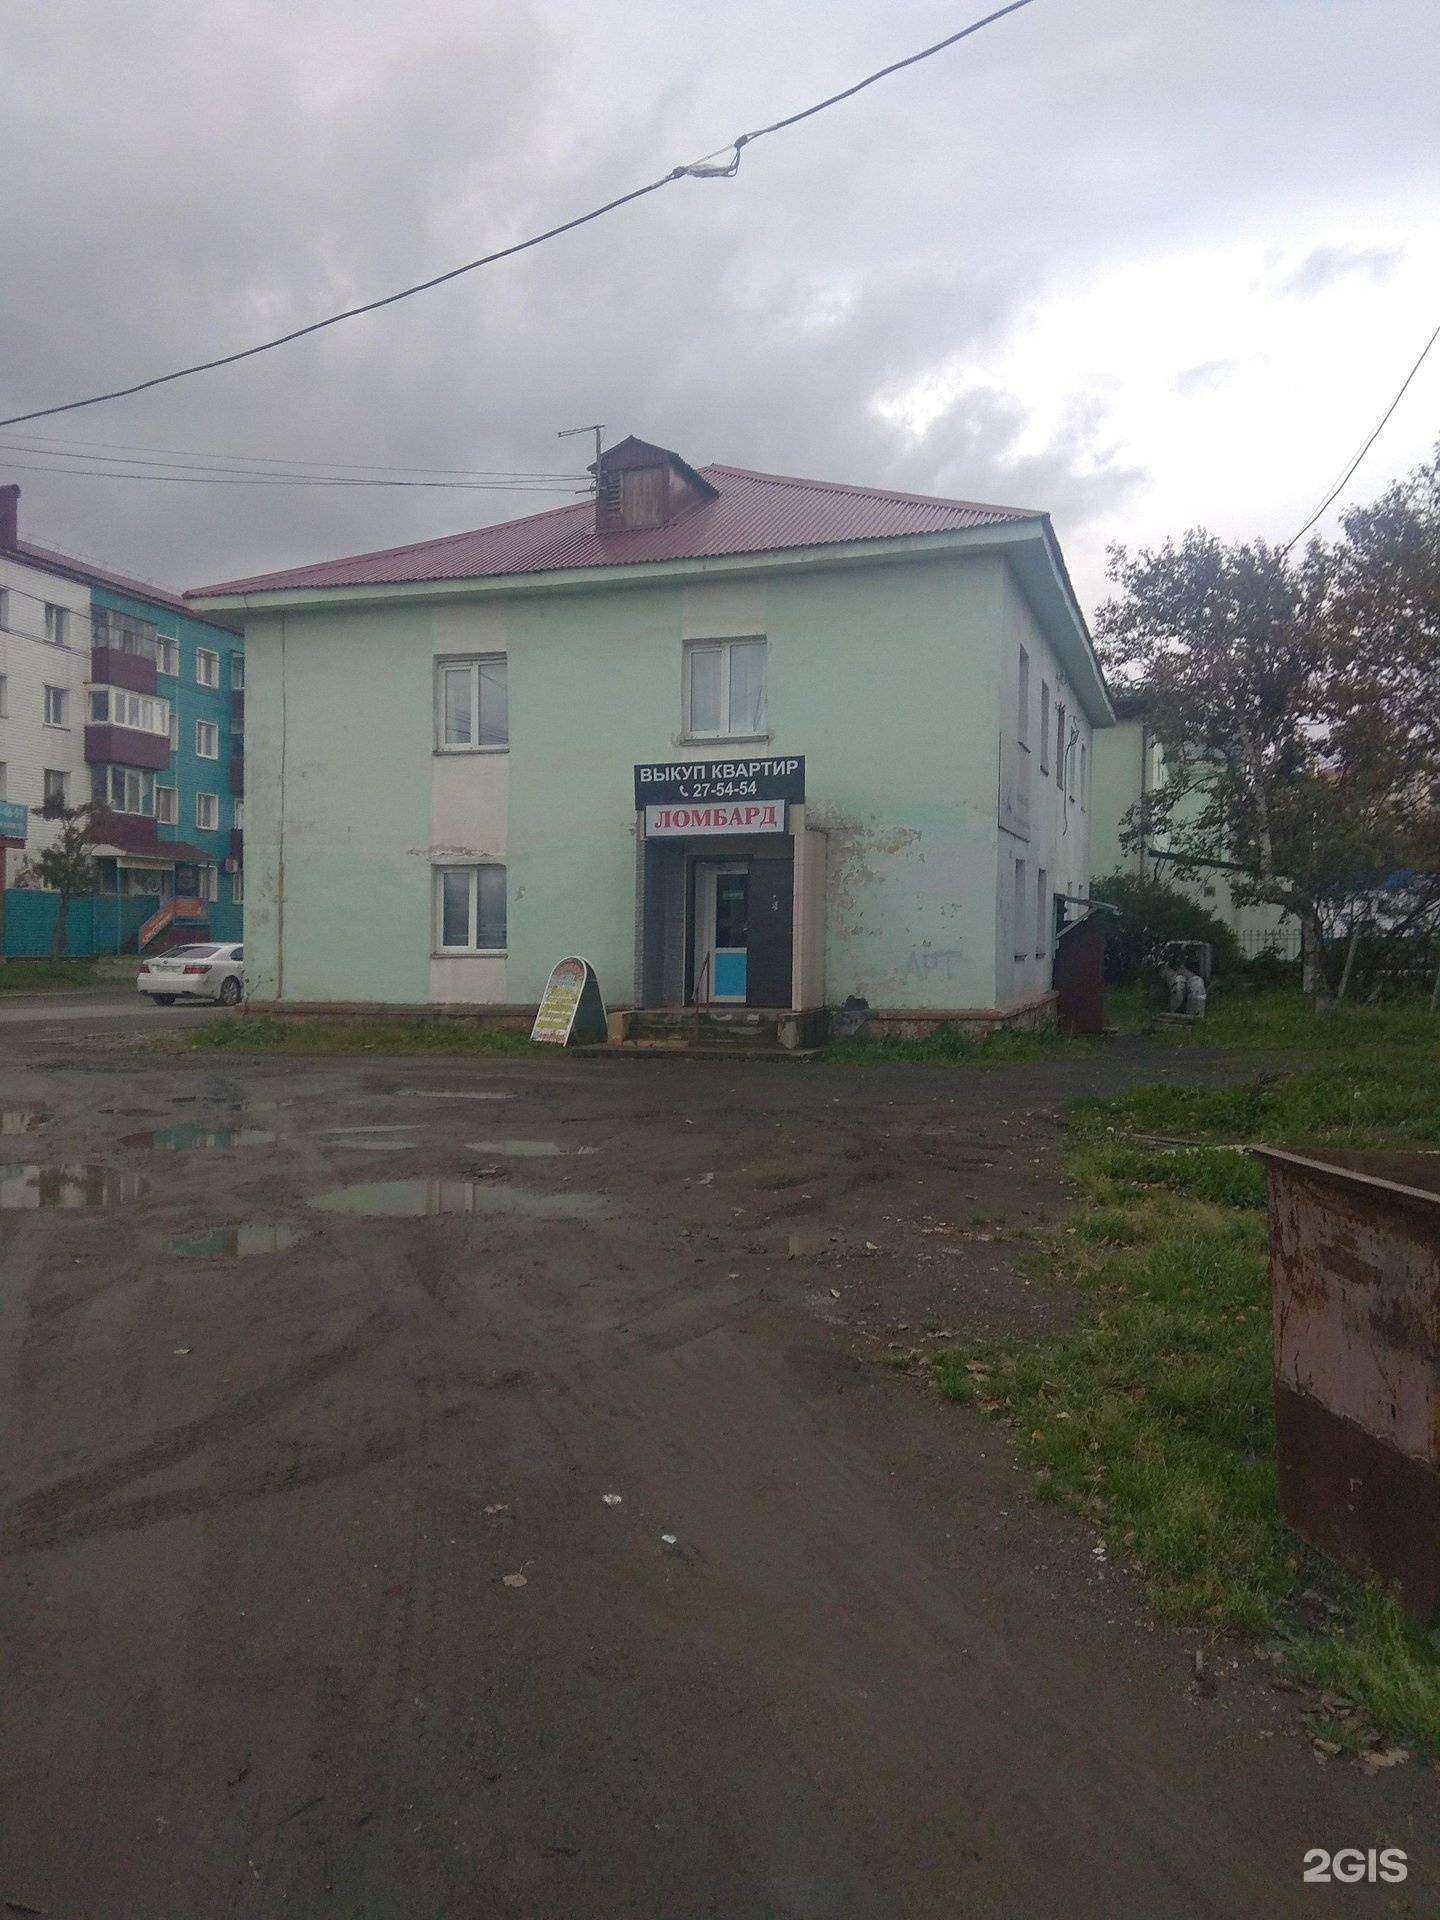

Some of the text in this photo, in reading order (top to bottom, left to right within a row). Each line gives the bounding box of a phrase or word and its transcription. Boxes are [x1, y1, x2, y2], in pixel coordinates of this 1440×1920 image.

[640, 760, 798, 782] ВЫКУП КВАРТИР
[693, 781, 756, 797] 27-54-54
[655, 806, 777, 828] ЛОМБАРД
